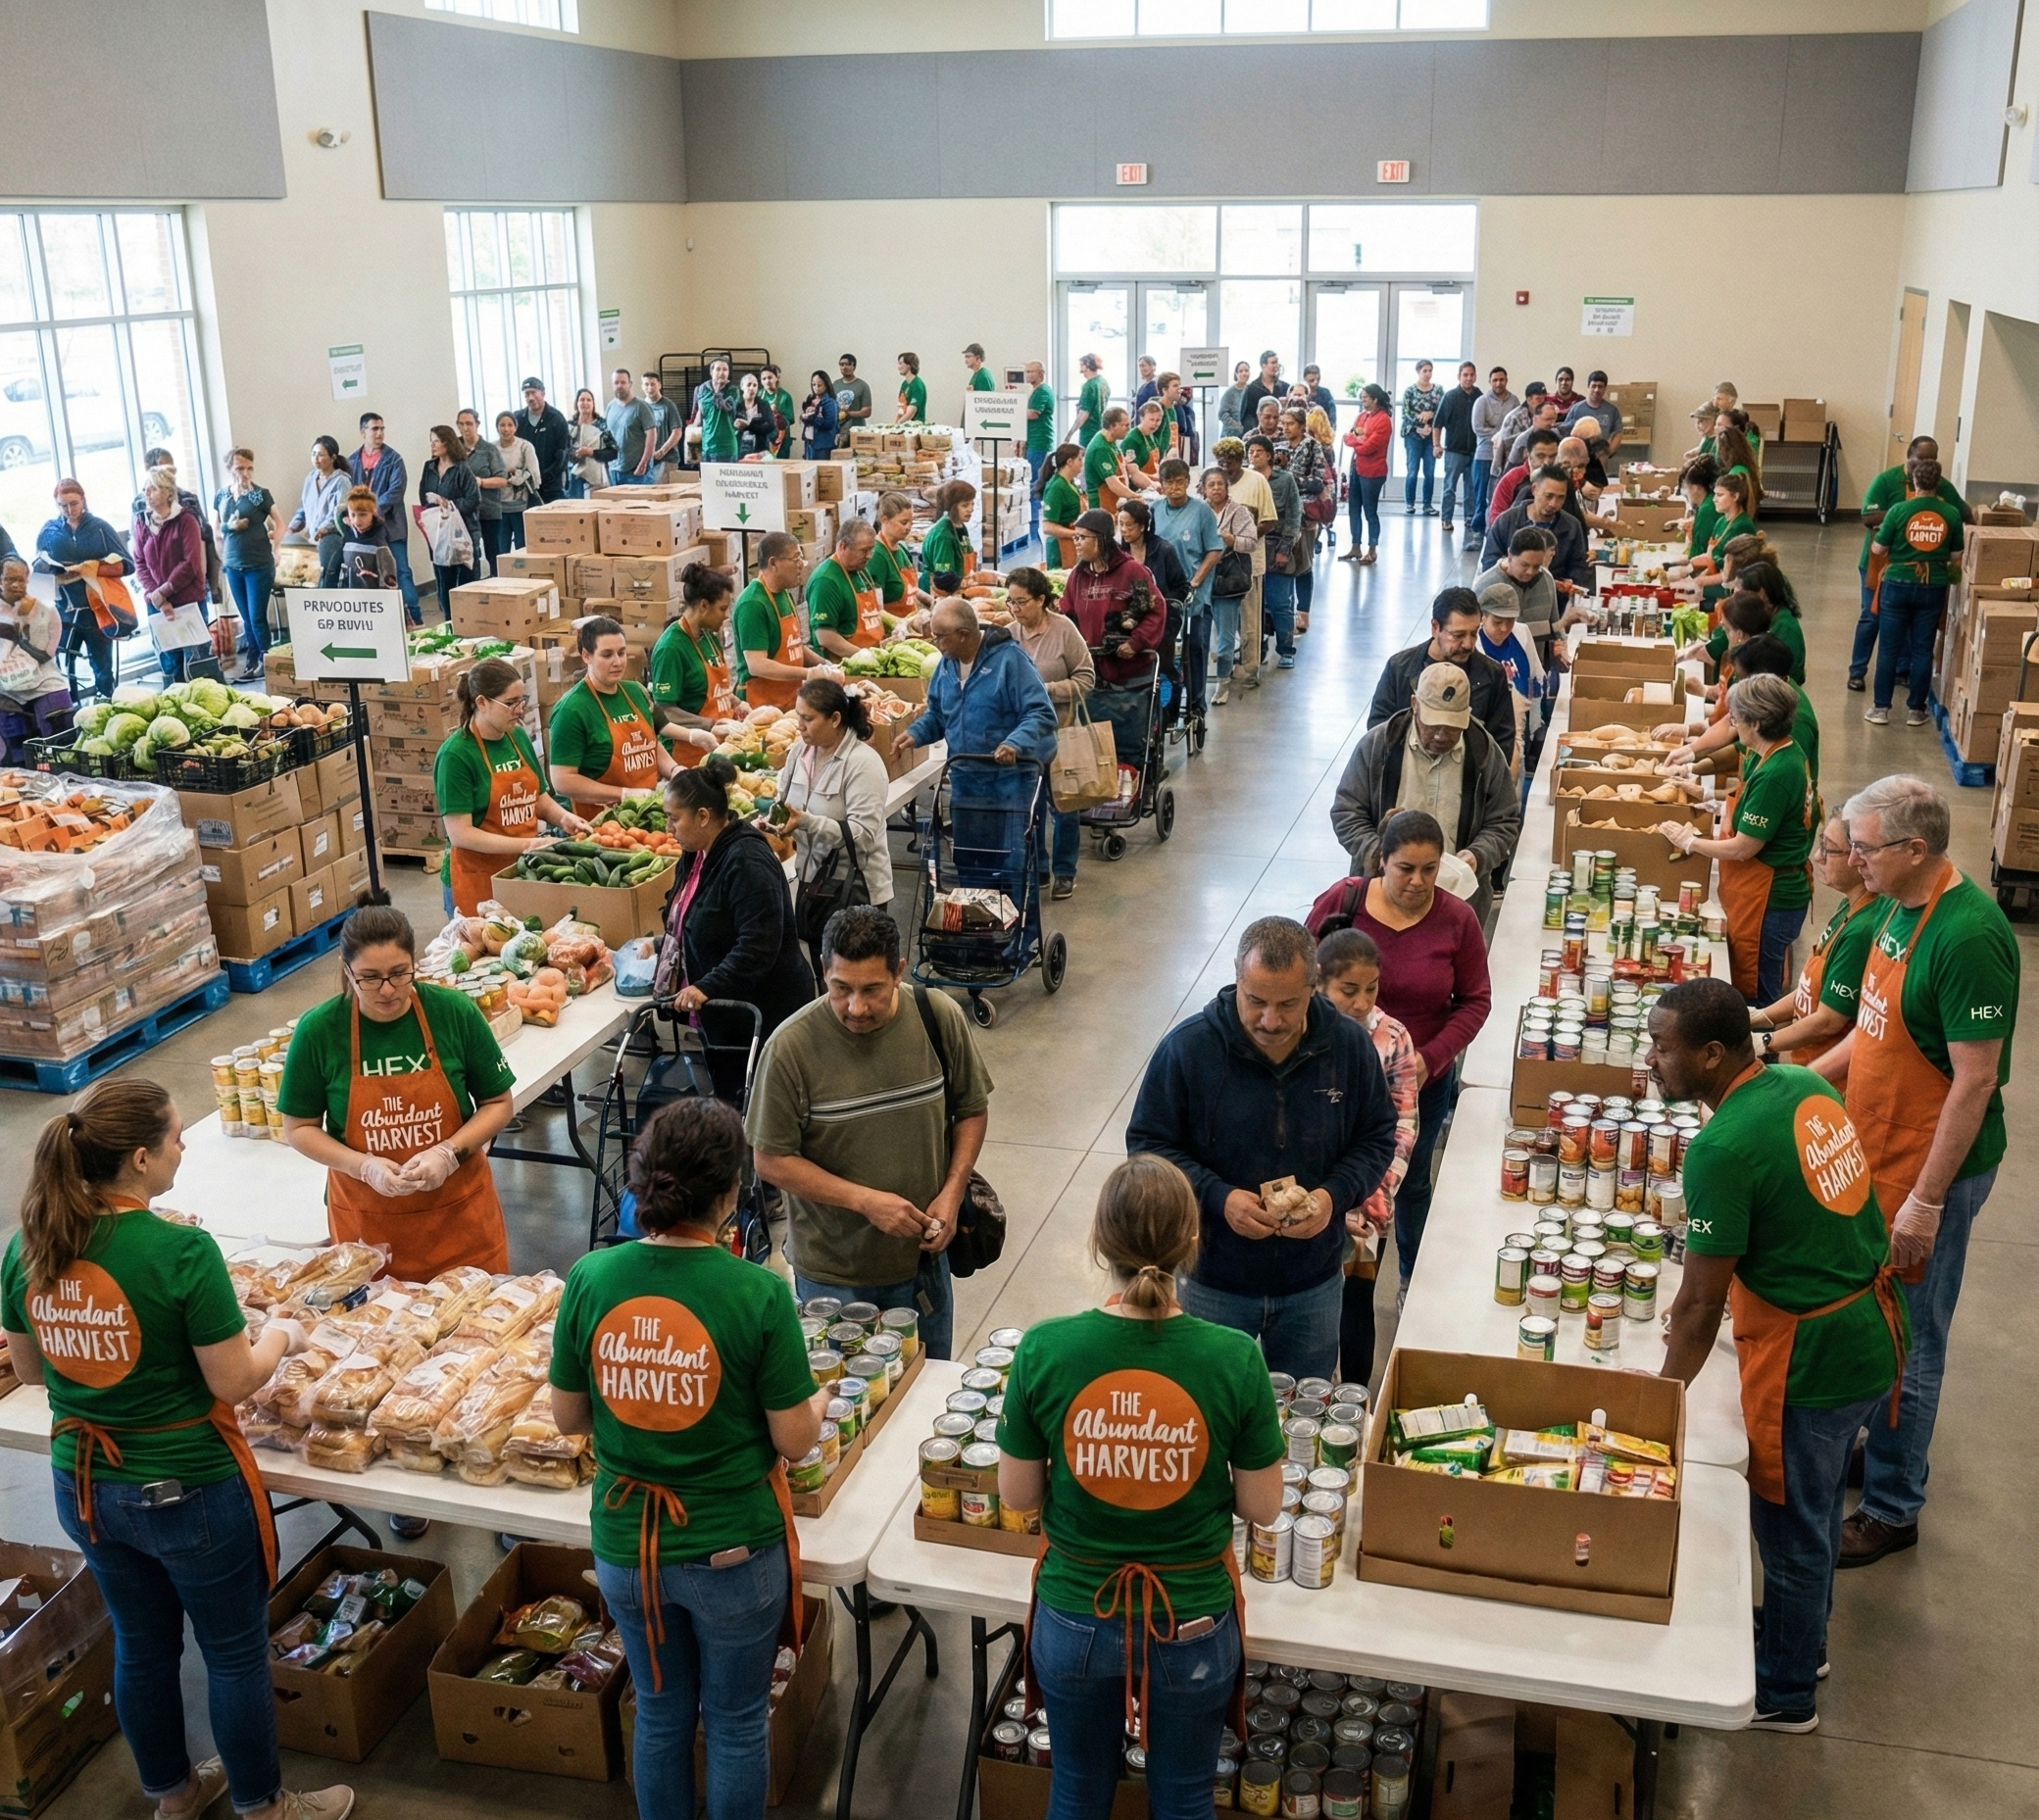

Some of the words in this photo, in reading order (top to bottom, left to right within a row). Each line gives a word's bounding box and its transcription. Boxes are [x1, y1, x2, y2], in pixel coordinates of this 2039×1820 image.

[1121, 165, 1142, 182] EXIT
[1382, 162, 1405, 181] EXIT
[1830, 979, 1859, 1000] HEX
[1970, 1005, 2004, 1020] HEX
[361, 1102, 443, 1128] Abundant
[365, 1119, 443, 1152] HARVEST
[59, 1279, 83, 1302] THE
[31, 1294, 129, 1327] Abundant
[632, 1315, 662, 1342] THE
[38, 1325, 129, 1361] HARVEST
[598, 1331, 711, 1371] Abundant
[602, 1364, 709, 1407] HARVEST
[1110, 1391, 1142, 1417] THE
[1072, 1407, 1199, 1445] Abundant
[1075, 1442, 1197, 1483] HARVEST
